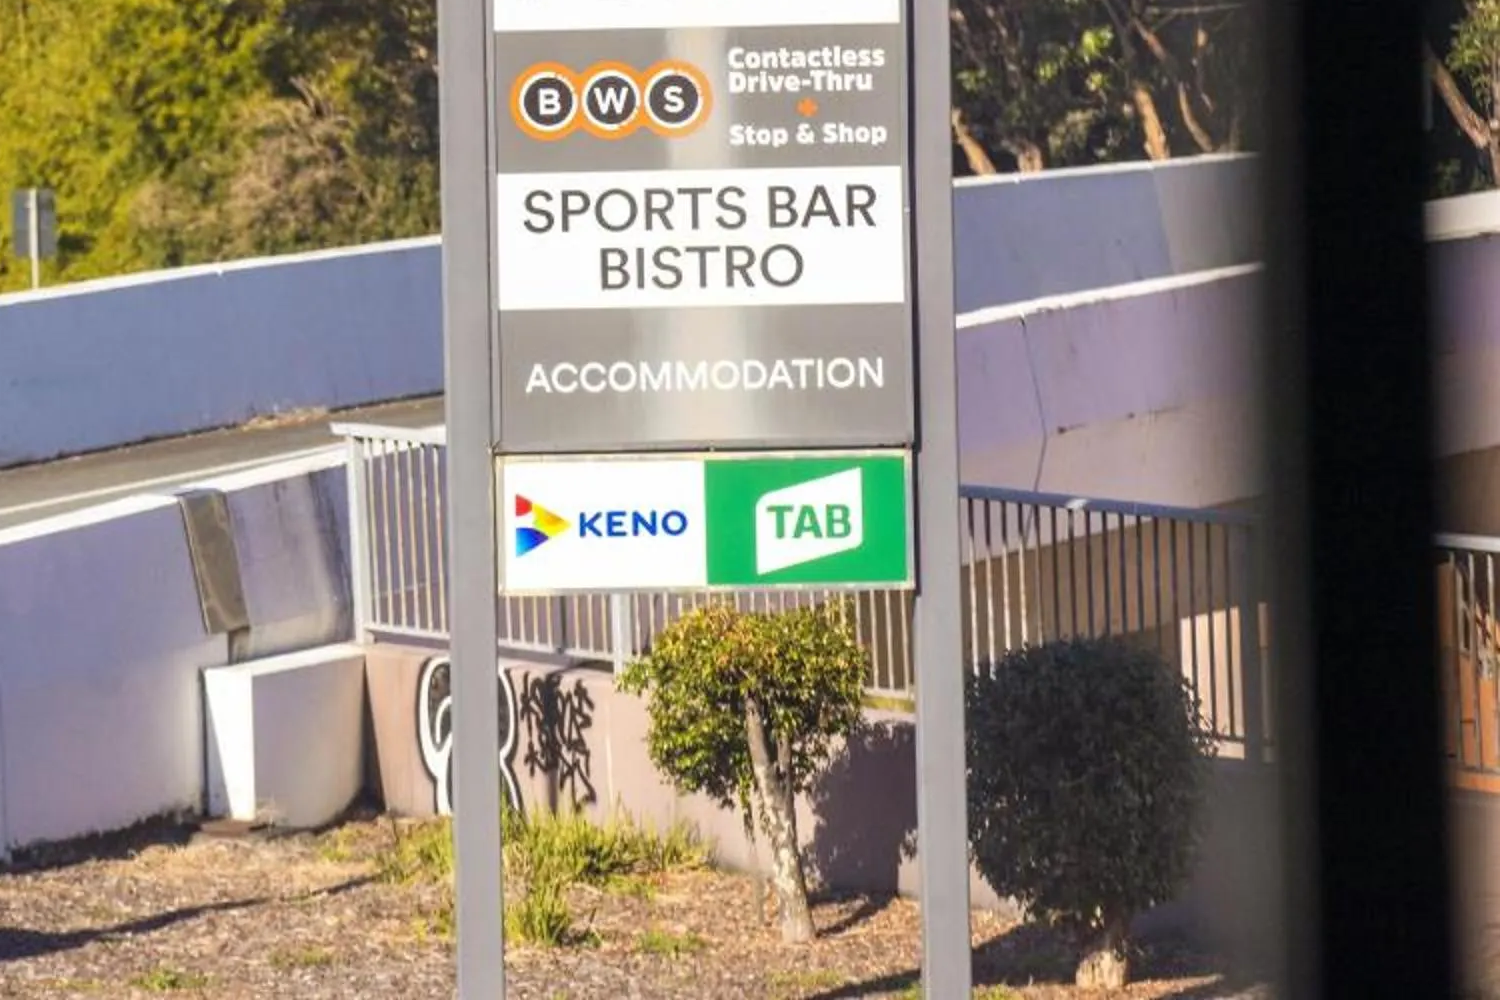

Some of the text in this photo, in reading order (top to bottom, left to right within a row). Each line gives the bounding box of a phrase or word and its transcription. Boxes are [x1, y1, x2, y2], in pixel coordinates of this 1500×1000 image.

[728, 45, 886, 70] Contactless
[728, 69, 874, 94] Drive-Thru
[729, 121, 887, 148] Stop & Shop
[523, 183, 877, 235] SPORTS BAR
[600, 242, 804, 291] BISTRO
[525, 356, 885, 394] ACCOMMODATION
[578, 509, 688, 538] KENO
[766, 503, 852, 540] TAB
